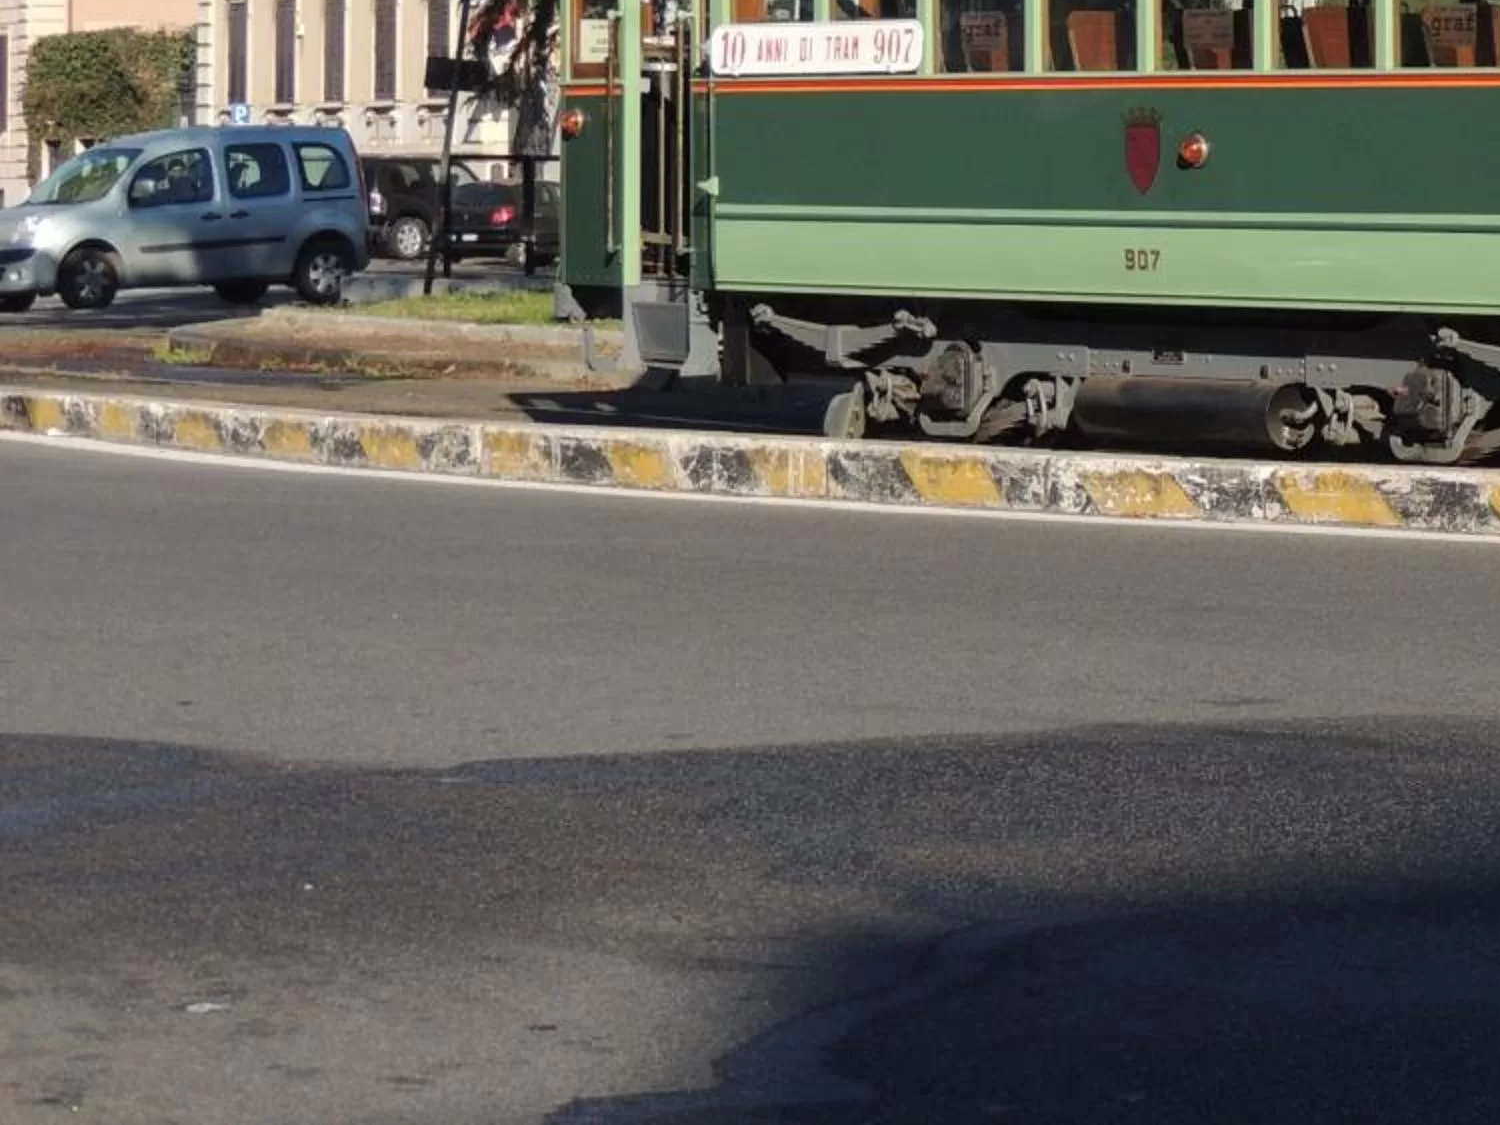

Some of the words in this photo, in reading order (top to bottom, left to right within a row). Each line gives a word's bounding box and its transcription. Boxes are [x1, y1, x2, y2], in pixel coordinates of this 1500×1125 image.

[720, 31, 746, 69] 10
[757, 36, 789, 62] ANNI
[799, 36, 814, 62] DI
[825, 35, 860, 61] TRAM
[873, 28, 915, 64] 907
[1124, 248, 1161, 272] 907
